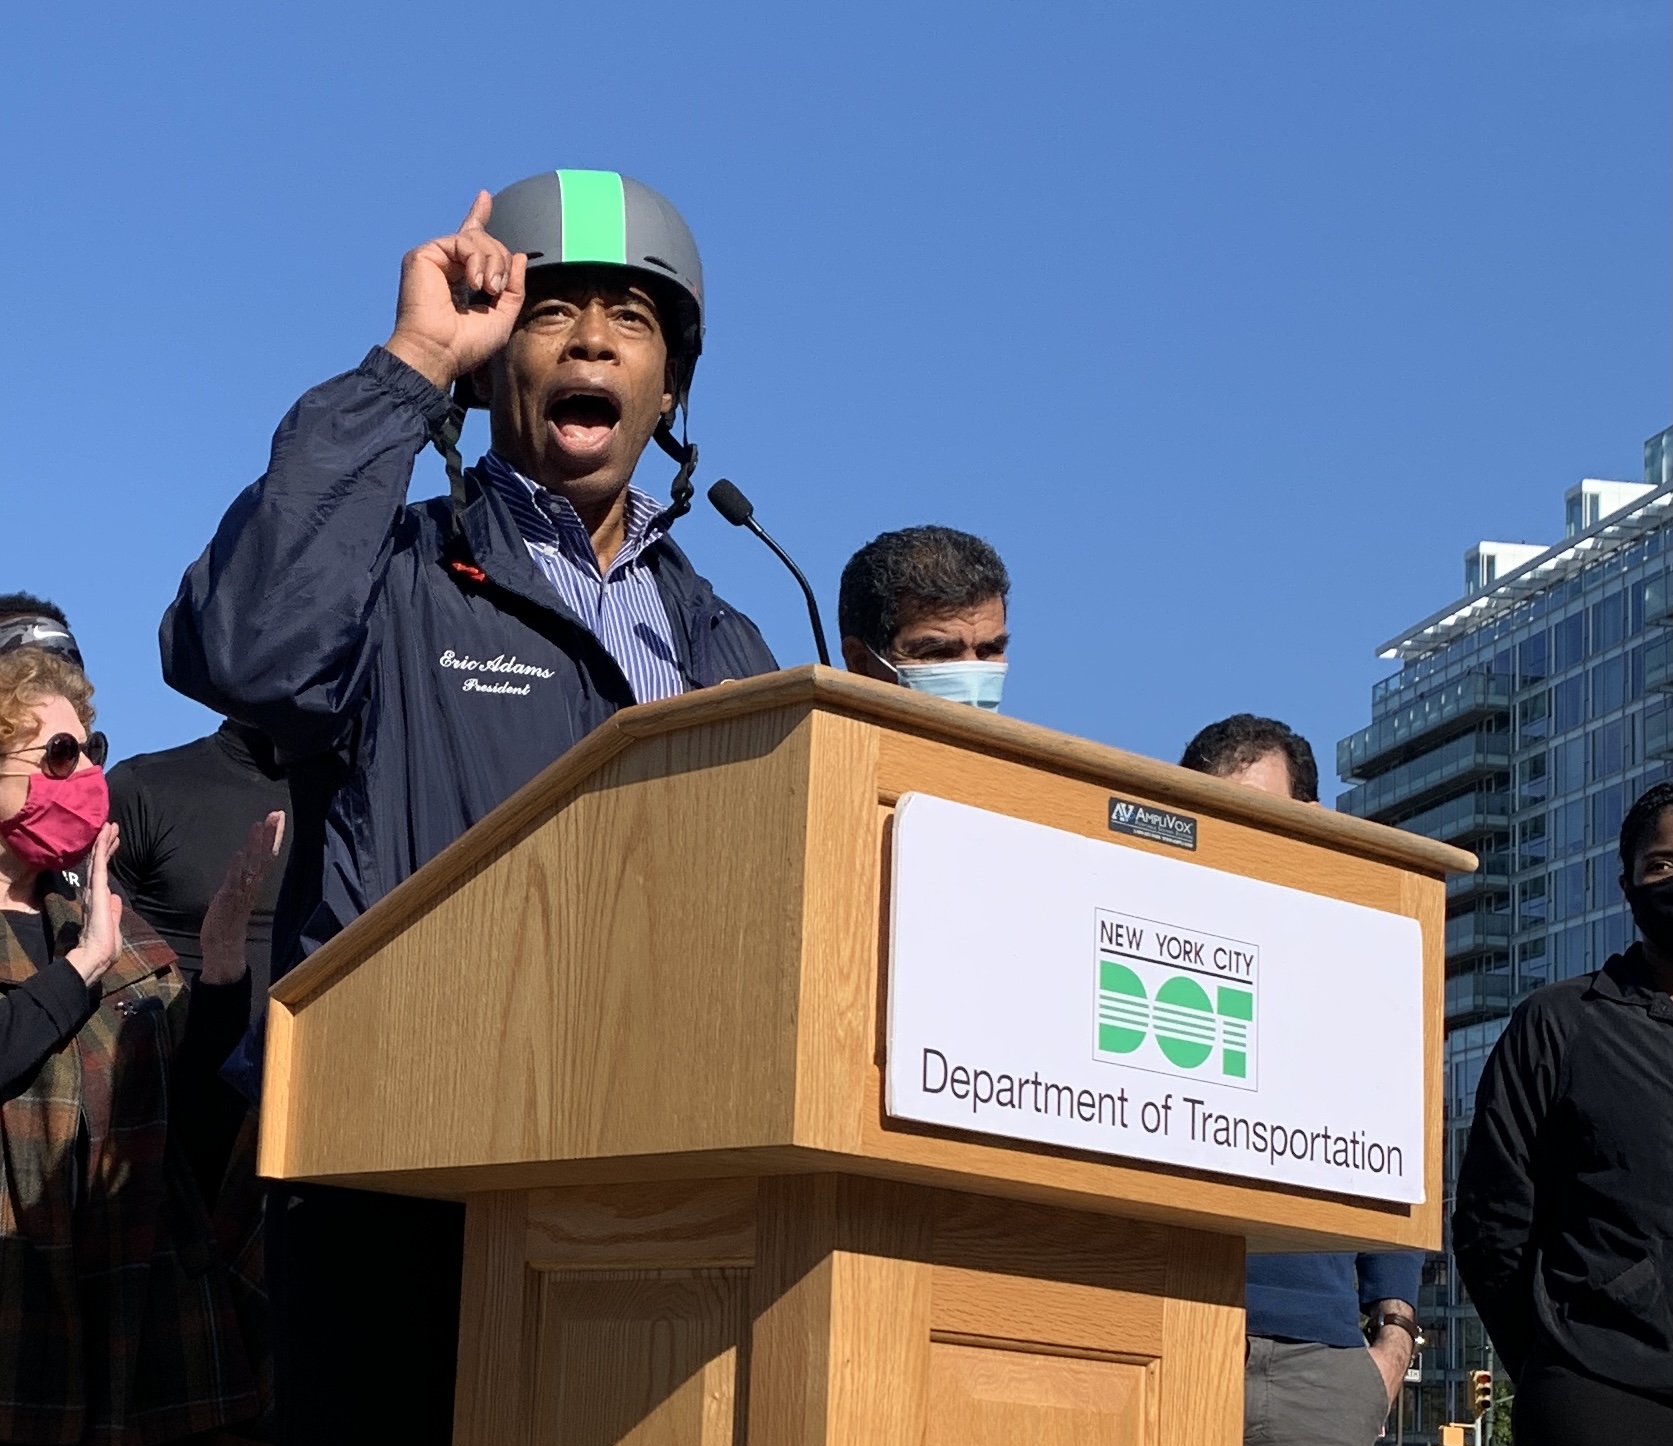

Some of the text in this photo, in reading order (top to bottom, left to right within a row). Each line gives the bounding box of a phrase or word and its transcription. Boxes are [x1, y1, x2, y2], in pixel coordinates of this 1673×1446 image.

[439, 650, 555, 678] Eric Adams
[462, 678, 531, 695] President
[1100, 919, 1254, 976] NEW YORK CITY
[1099, 960, 1253, 1079] DOT
[922, 1047, 1403, 1177] Department of Transportation
